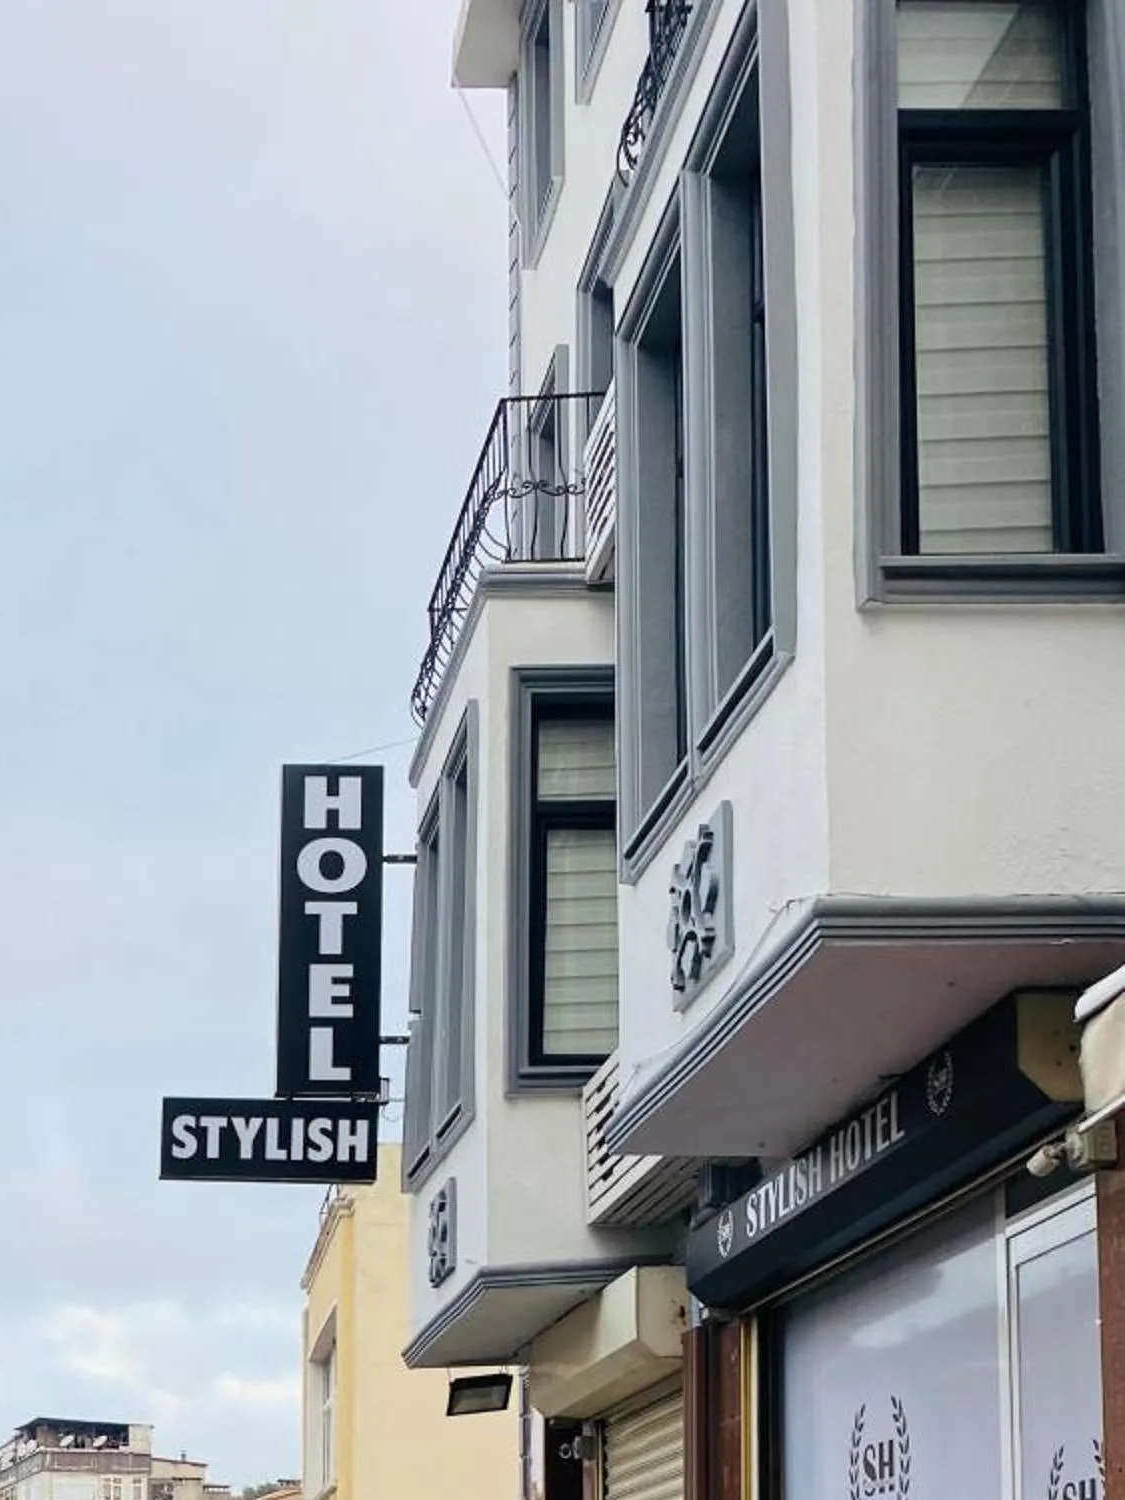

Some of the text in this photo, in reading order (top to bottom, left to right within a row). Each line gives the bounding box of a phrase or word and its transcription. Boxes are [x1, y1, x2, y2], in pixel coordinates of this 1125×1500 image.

[296, 775, 367, 1082] HOTEL
[171, 1114, 370, 1164] STYLISH
[745, 1091, 905, 1238] STYLISH HOTEL
[862, 1438, 895, 1497] SH
